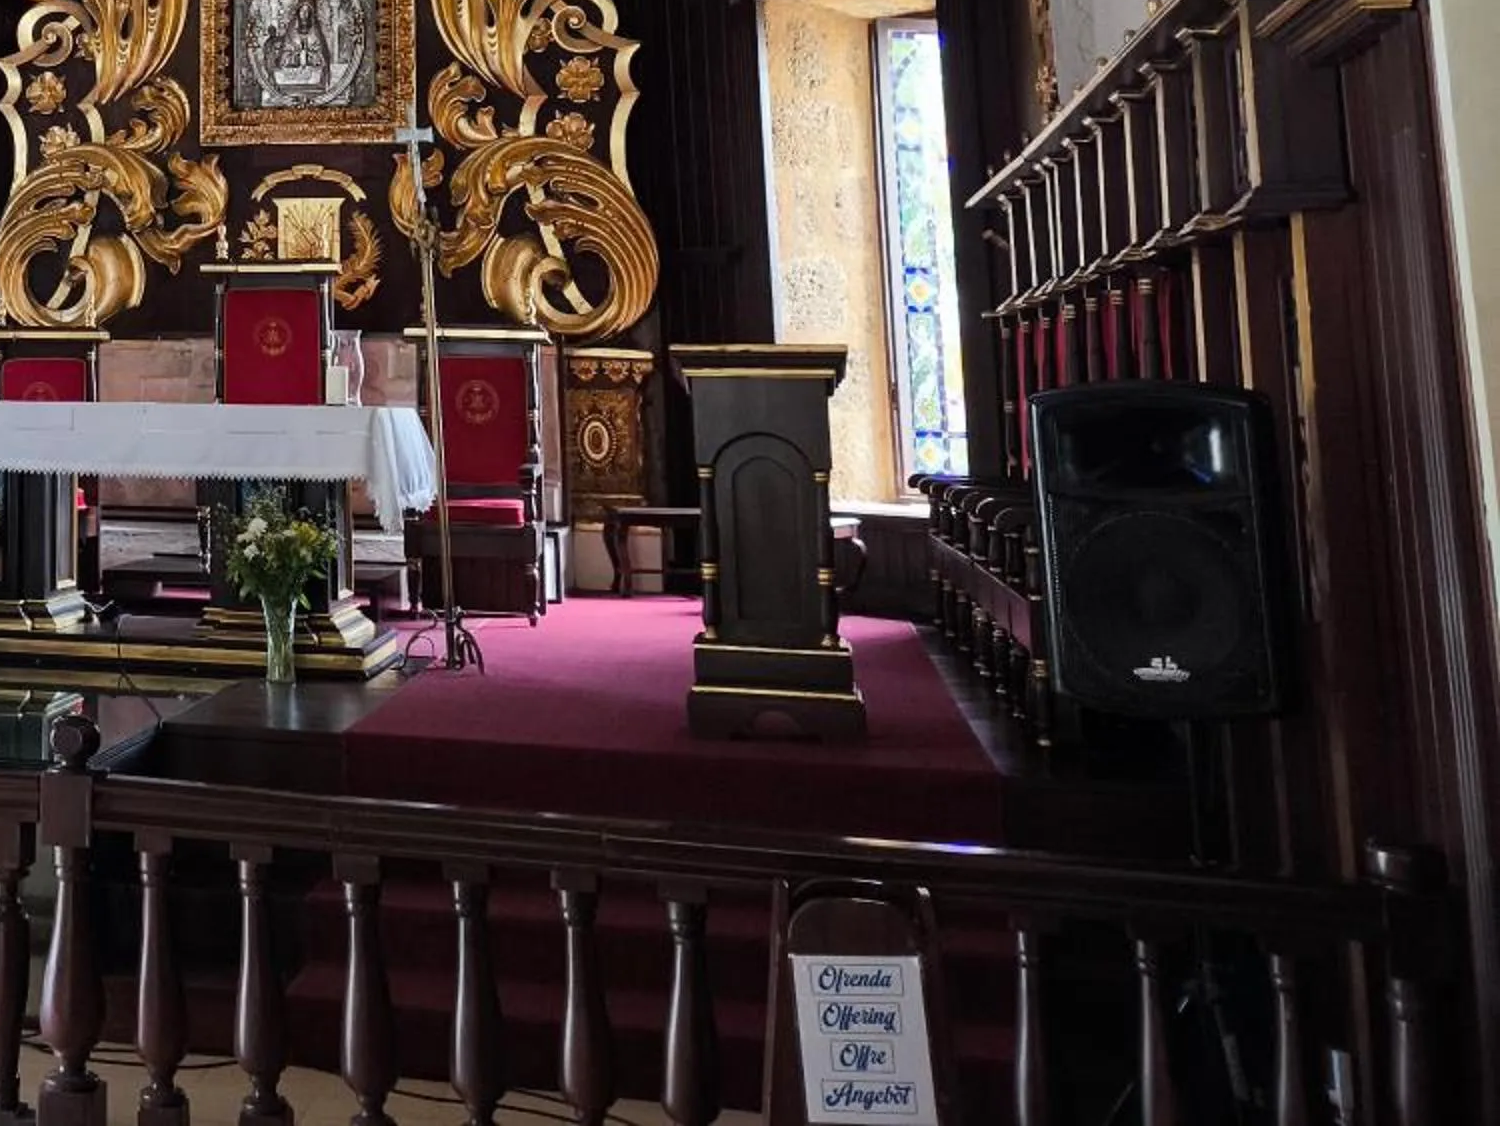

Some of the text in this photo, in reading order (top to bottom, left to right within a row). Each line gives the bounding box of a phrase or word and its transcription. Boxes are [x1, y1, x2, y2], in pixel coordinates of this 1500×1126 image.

[818, 964, 893, 993] Ofrenda
[822, 1002, 897, 1033] Offering
[839, 1043, 887, 1071] Offre
[825, 1082, 911, 1110] Angebot
